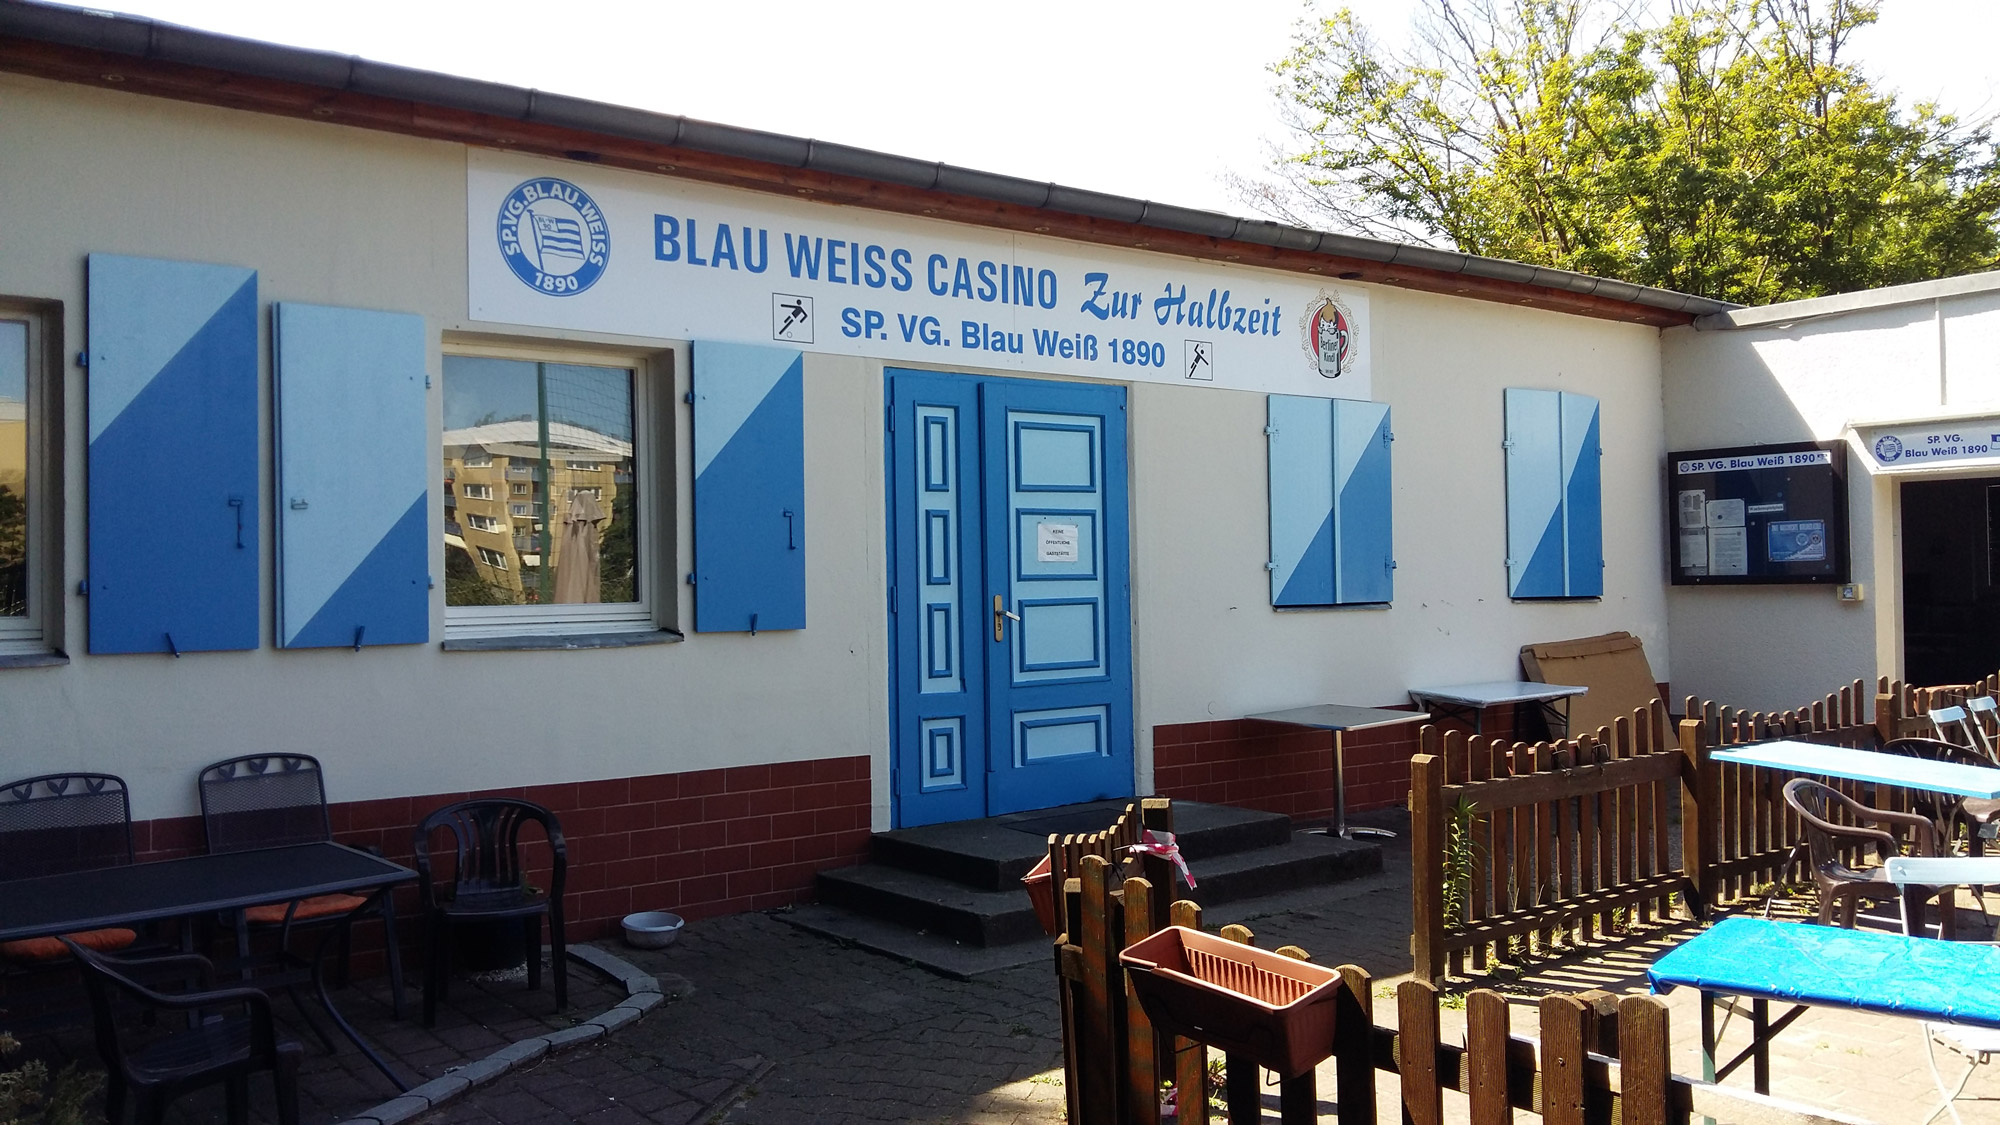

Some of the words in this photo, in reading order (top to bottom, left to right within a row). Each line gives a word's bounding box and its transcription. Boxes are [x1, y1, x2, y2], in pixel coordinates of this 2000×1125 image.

[535, 272, 578, 292] 1890
[654, 213, 769, 274] BLAU
[784, 232, 913, 292] WEISS
[927, 253, 1057, 310] CASINO
[1081, 272, 1142, 320] Zur
[1154, 282, 1281, 337] Halbzeit
[841, 307, 888, 341] SP.
[897, 312, 951, 347] VG.
[961, 320, 1024, 354] Blau
[1032, 328, 1099, 361] Weiß
[1108, 338, 1166, 368] 1890
[1927, 435, 1941, 444] SP.
[1944, 434, 1964, 442] VG.
[1905, 449, 1928, 458] Blau
[1931, 447, 1958, 456] Weiß
[1961, 445, 1988, 454] 1890
[1691, 461, 1705, 471] SP.
[1708, 461, 1727, 470] VG.
[1730, 460, 1754, 469] Blau
[1757, 456, 1785, 466] Weiß
[1788, 453, 1815, 464] 1890
